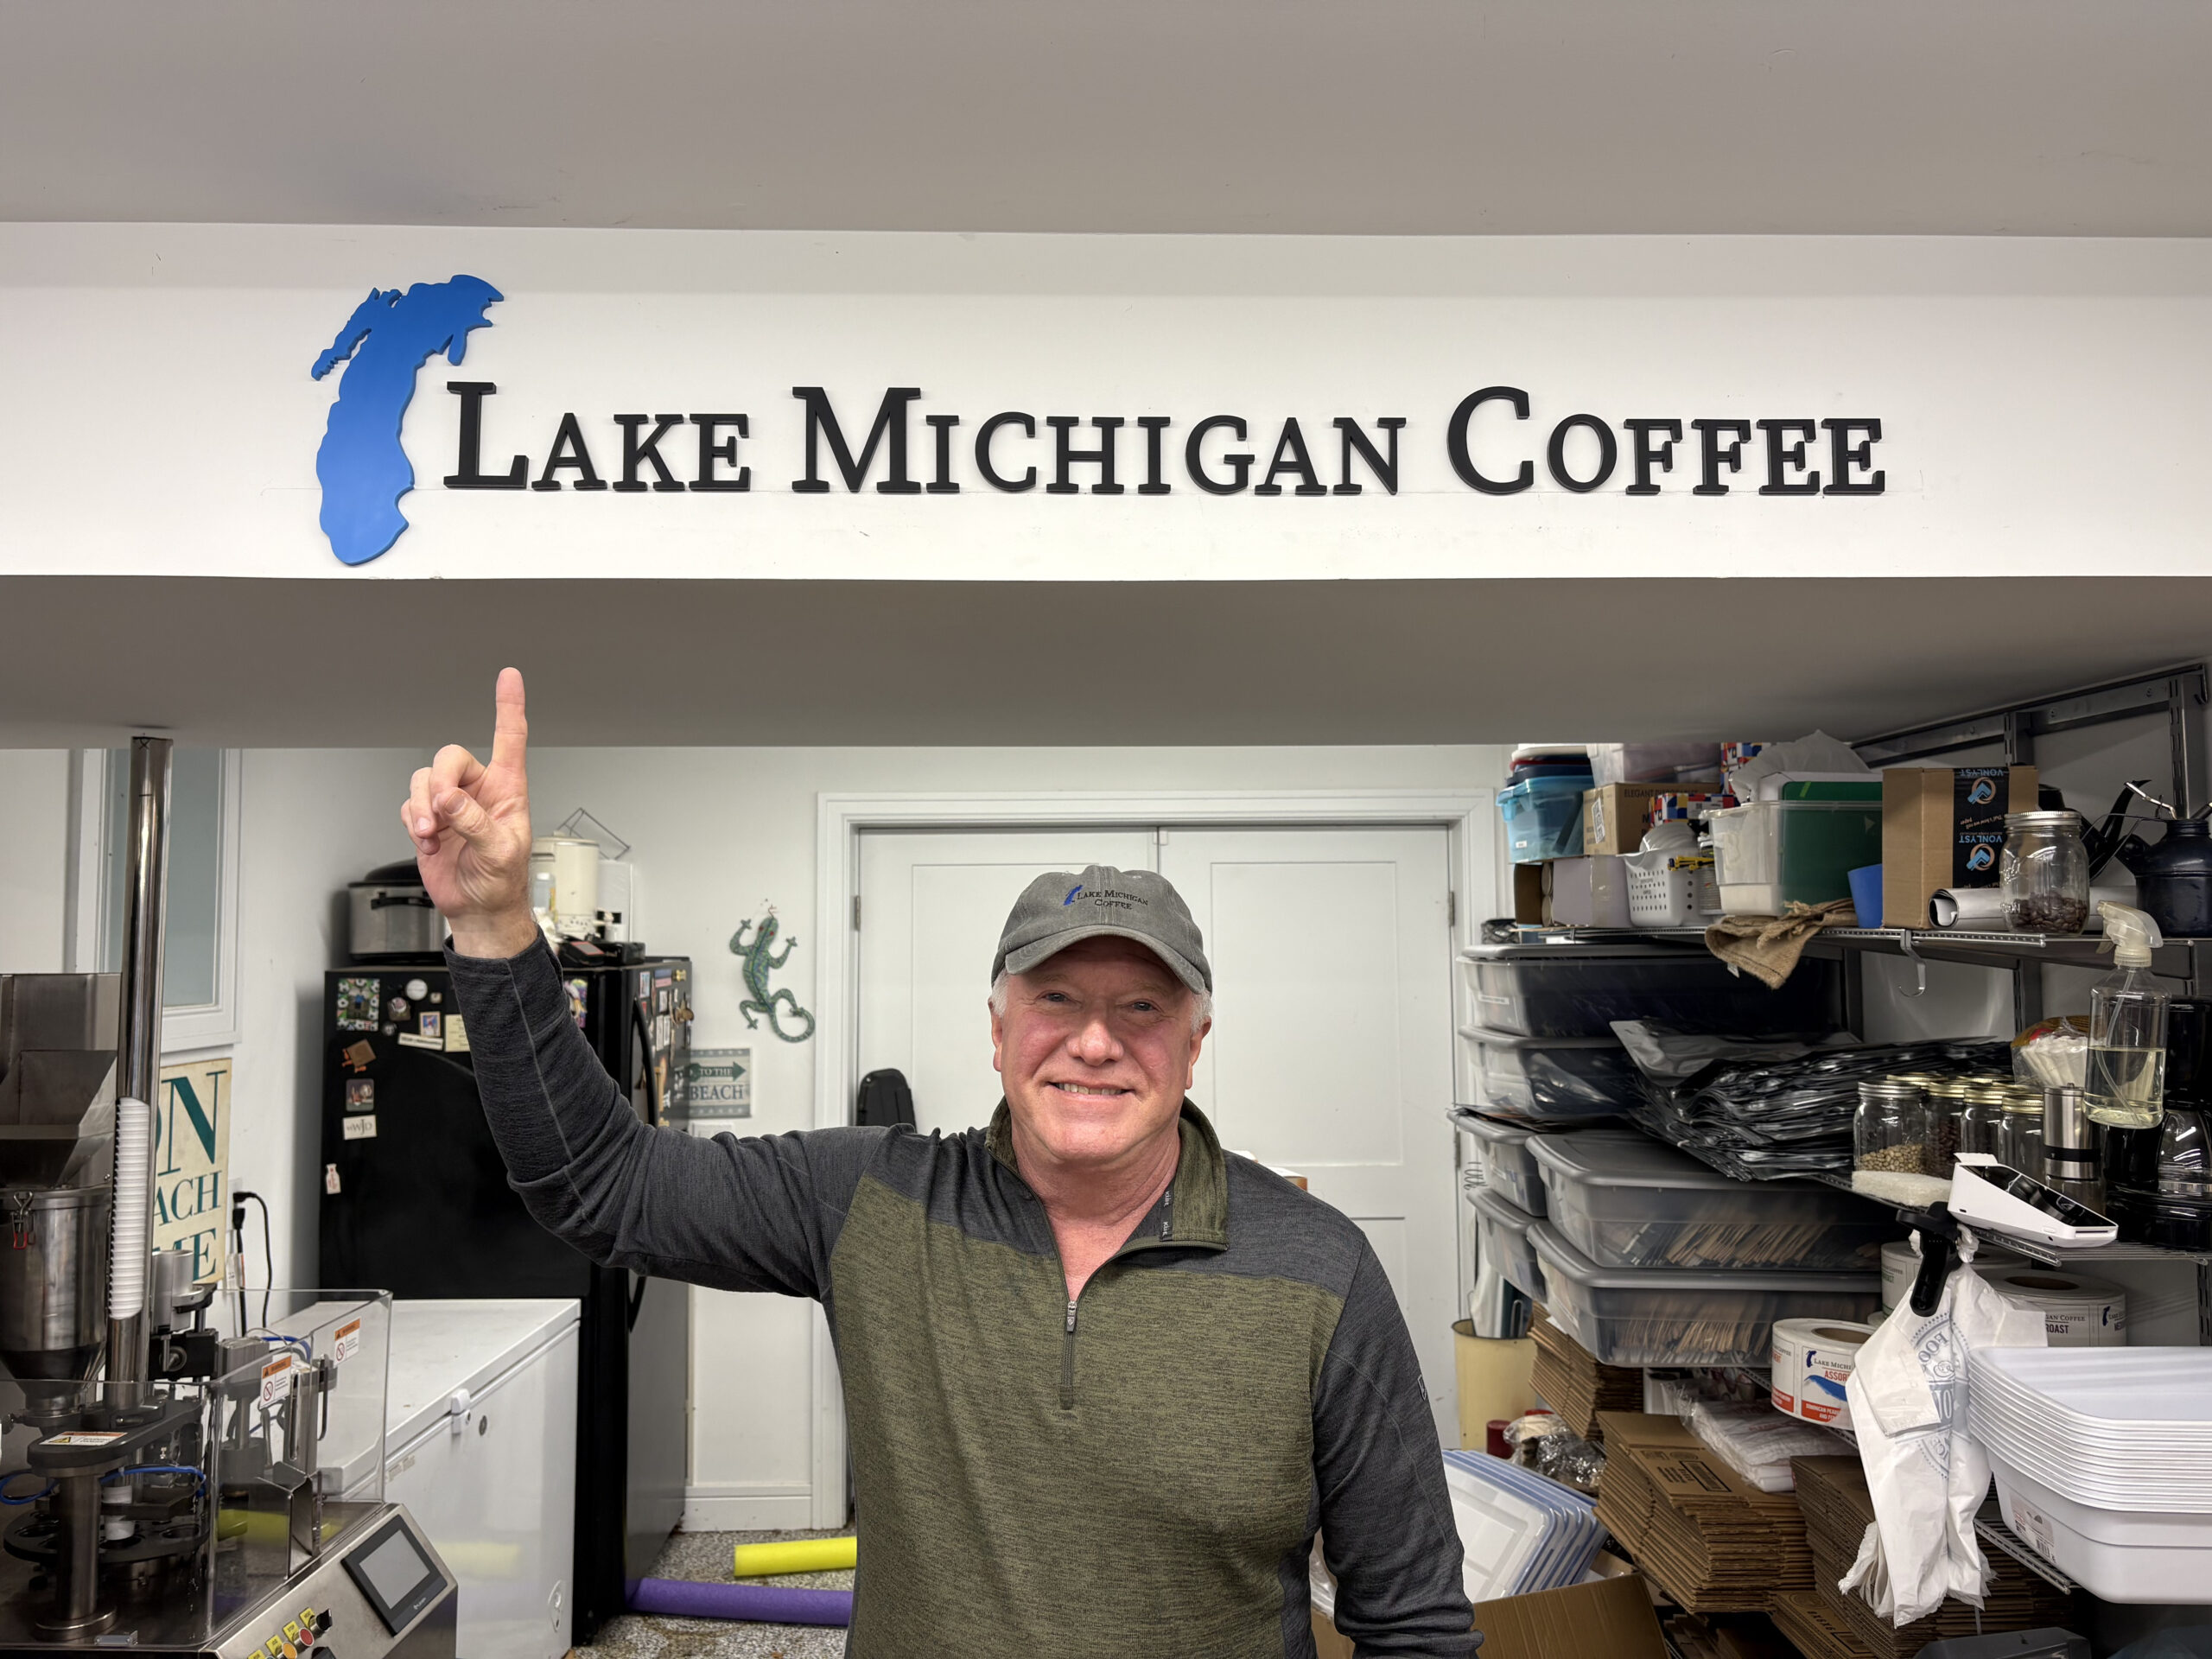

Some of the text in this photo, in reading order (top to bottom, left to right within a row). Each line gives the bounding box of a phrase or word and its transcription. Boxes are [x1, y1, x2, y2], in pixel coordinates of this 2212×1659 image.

[443, 380, 1885, 496] LAKE MICHIGAN COFFEE
[1960, 768, 2005, 777] VONLYST
[1959, 835, 2003, 843] VONLYST
[1077, 889, 1148, 906] LAKE MICHIGAN
[1094, 899, 1133, 910] COFFEE
[714, 1067, 733, 1076] THE
[690, 1084, 743, 1100] BEACH
[156, 1070, 227, 1177] N
[1814, 1358, 1855, 1370] LAKE MICHI
